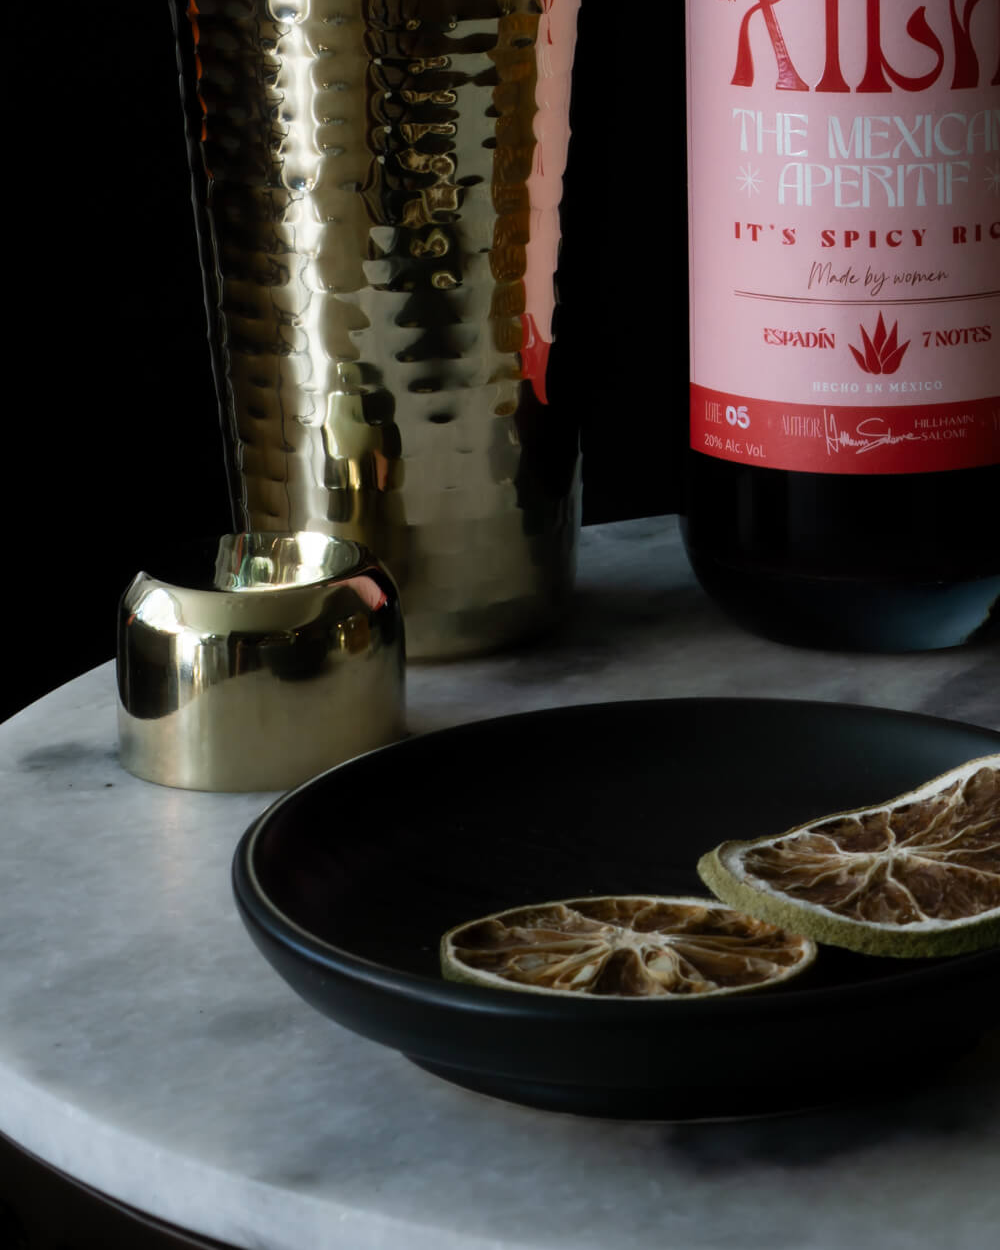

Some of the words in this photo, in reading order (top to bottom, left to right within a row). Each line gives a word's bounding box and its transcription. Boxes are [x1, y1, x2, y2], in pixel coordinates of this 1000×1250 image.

[732, 108, 809, 157] THE
[777, 161, 971, 208] APERITIF
[734, 221, 797, 246] IT'S
[821, 229, 927, 248] SPICY
[808, 261, 859, 290] Made
[864, 265, 890, 296] by
[893, 269, 950, 287] women
[764, 327, 836, 350] ESPADÍN
[923, 331, 932, 348] 7
[936, 325, 993, 347] NOTES
[813, 381, 860, 394] HECHO
[865, 383, 883, 394] EN
[724, 405, 751, 430] 05
[704, 432, 723, 450] 20%
[725, 438, 744, 454] Alc.
